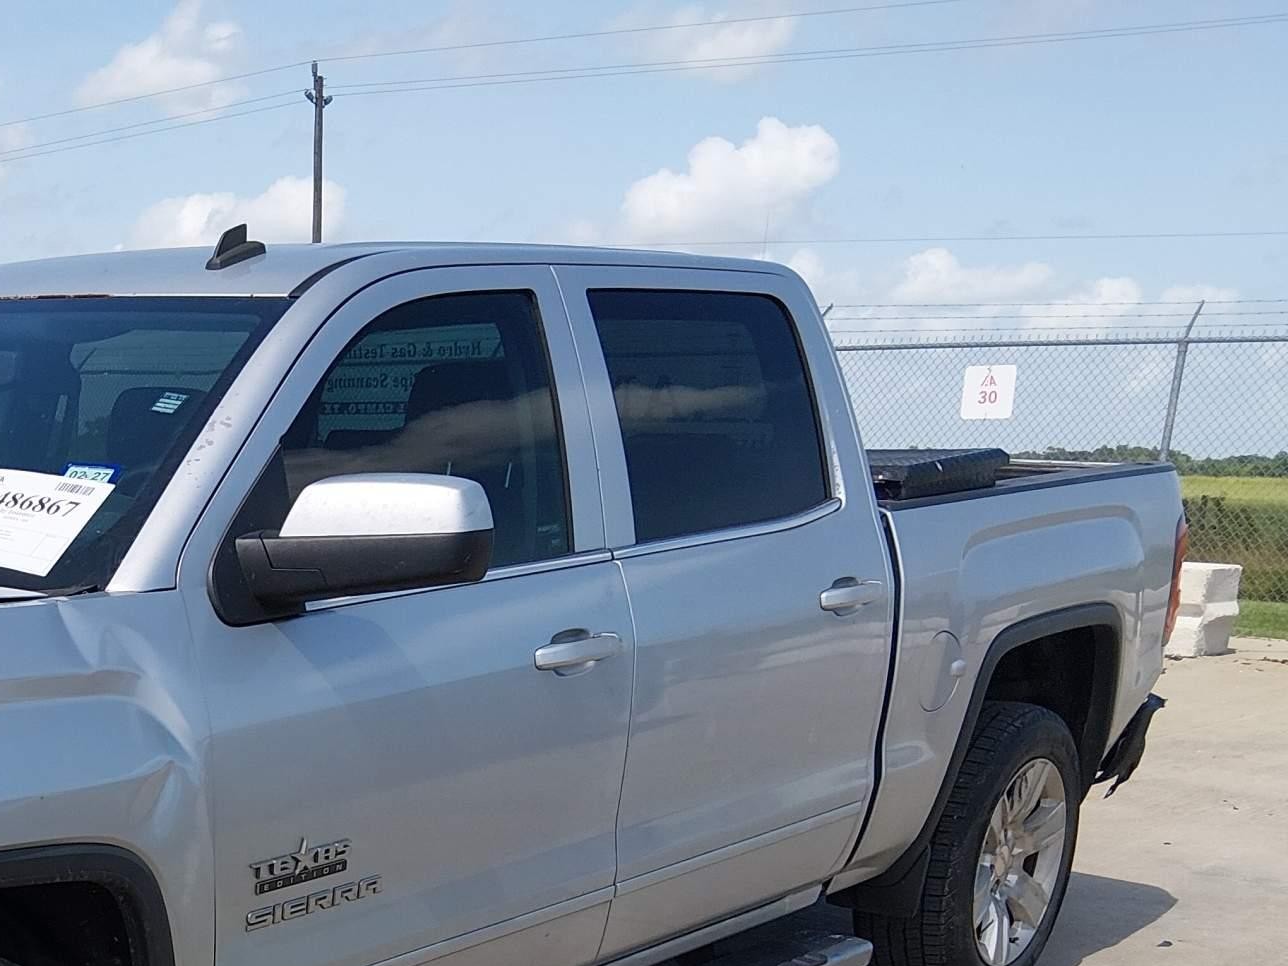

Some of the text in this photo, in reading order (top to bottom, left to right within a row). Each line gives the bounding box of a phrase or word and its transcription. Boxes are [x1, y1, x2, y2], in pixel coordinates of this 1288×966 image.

[977, 390, 998, 404] 30
[89, 471, 111, 481] 27
[249, 838, 352, 880] TEXAS
[262, 863, 344, 892] EDITION
[245, 873, 384, 933] SIERRA
